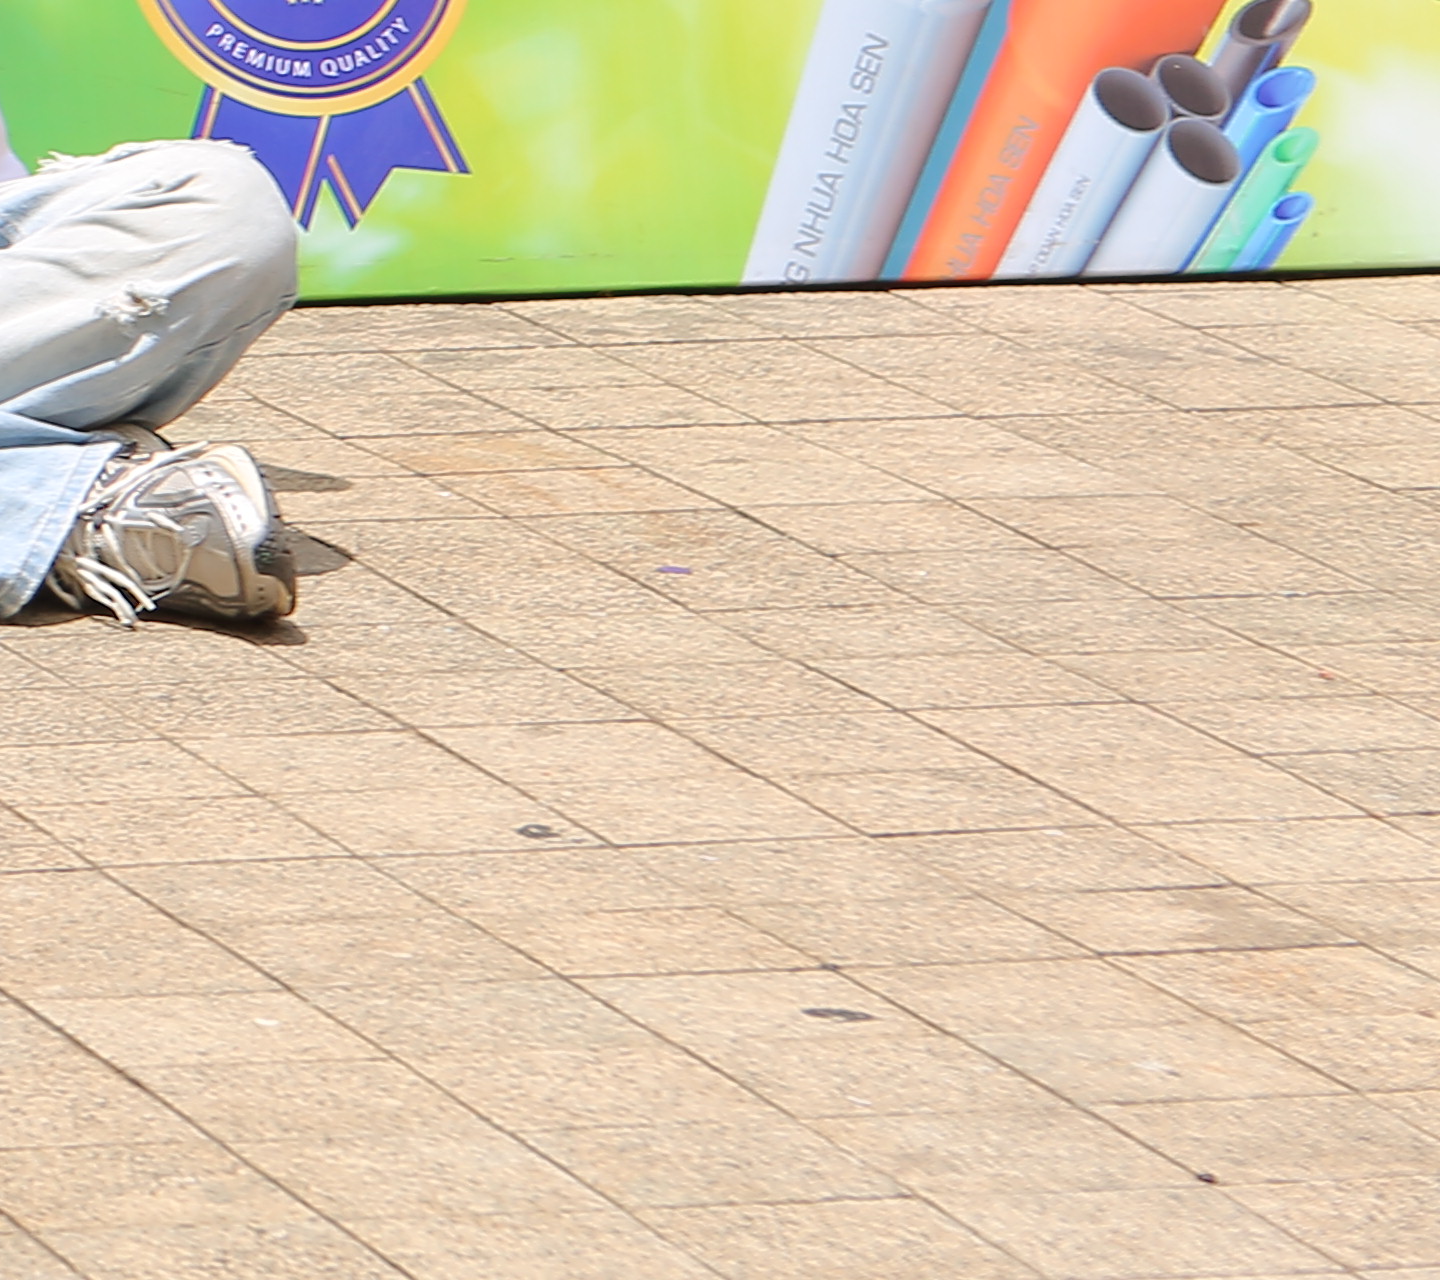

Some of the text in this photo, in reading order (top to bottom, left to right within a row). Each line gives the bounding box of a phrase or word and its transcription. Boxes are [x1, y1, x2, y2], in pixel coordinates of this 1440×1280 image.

[204, 16, 412, 79] PREMIUM QUALITY
[793, 171, 845, 259] NHUA
[824, 101, 868, 165] HOA
[849, 32, 891, 96] SEN
